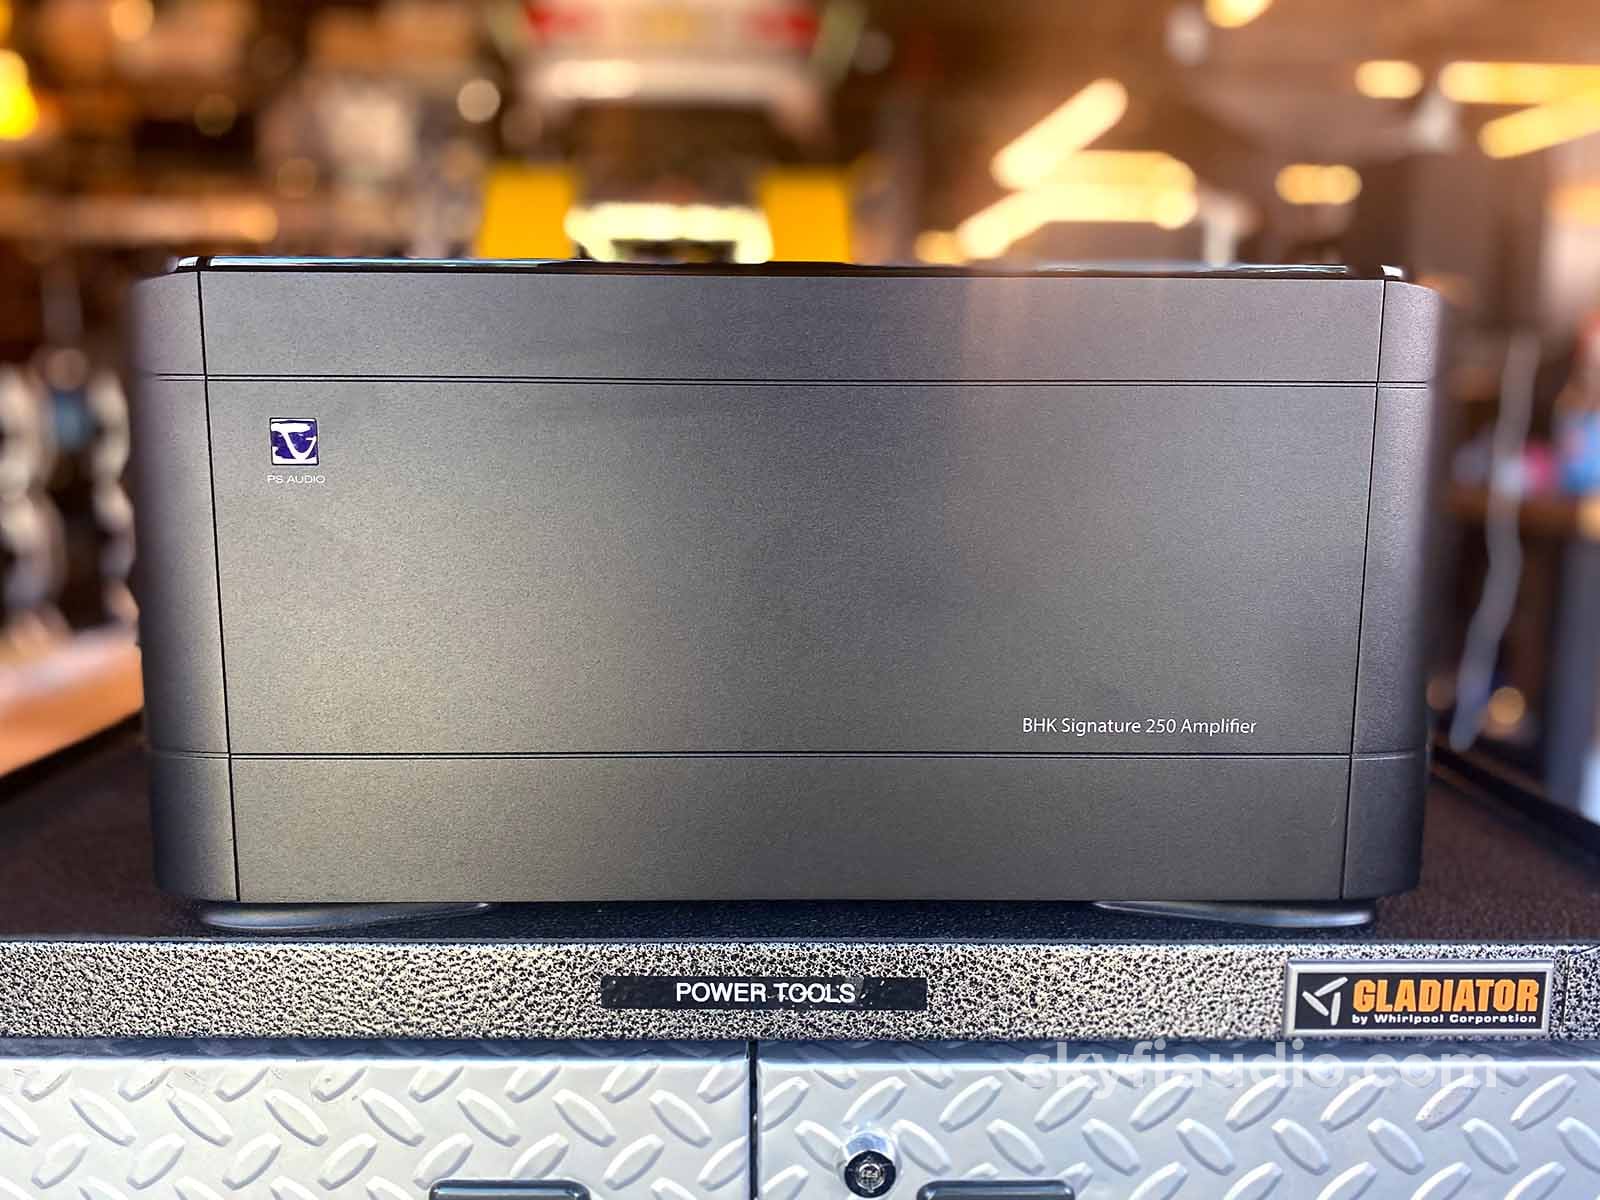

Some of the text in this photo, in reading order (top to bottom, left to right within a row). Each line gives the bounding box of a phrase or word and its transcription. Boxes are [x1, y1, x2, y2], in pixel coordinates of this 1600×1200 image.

[266, 474, 326, 484] PS AUDIO
[1022, 717, 1257, 737] BHK Signature 250 Amplifier
[675, 982, 856, 1004] POWER TOOLS
[1352, 978, 1540, 1013] GLADIATOR
[1351, 1013, 1537, 1025] by Whirlpool Corporation
